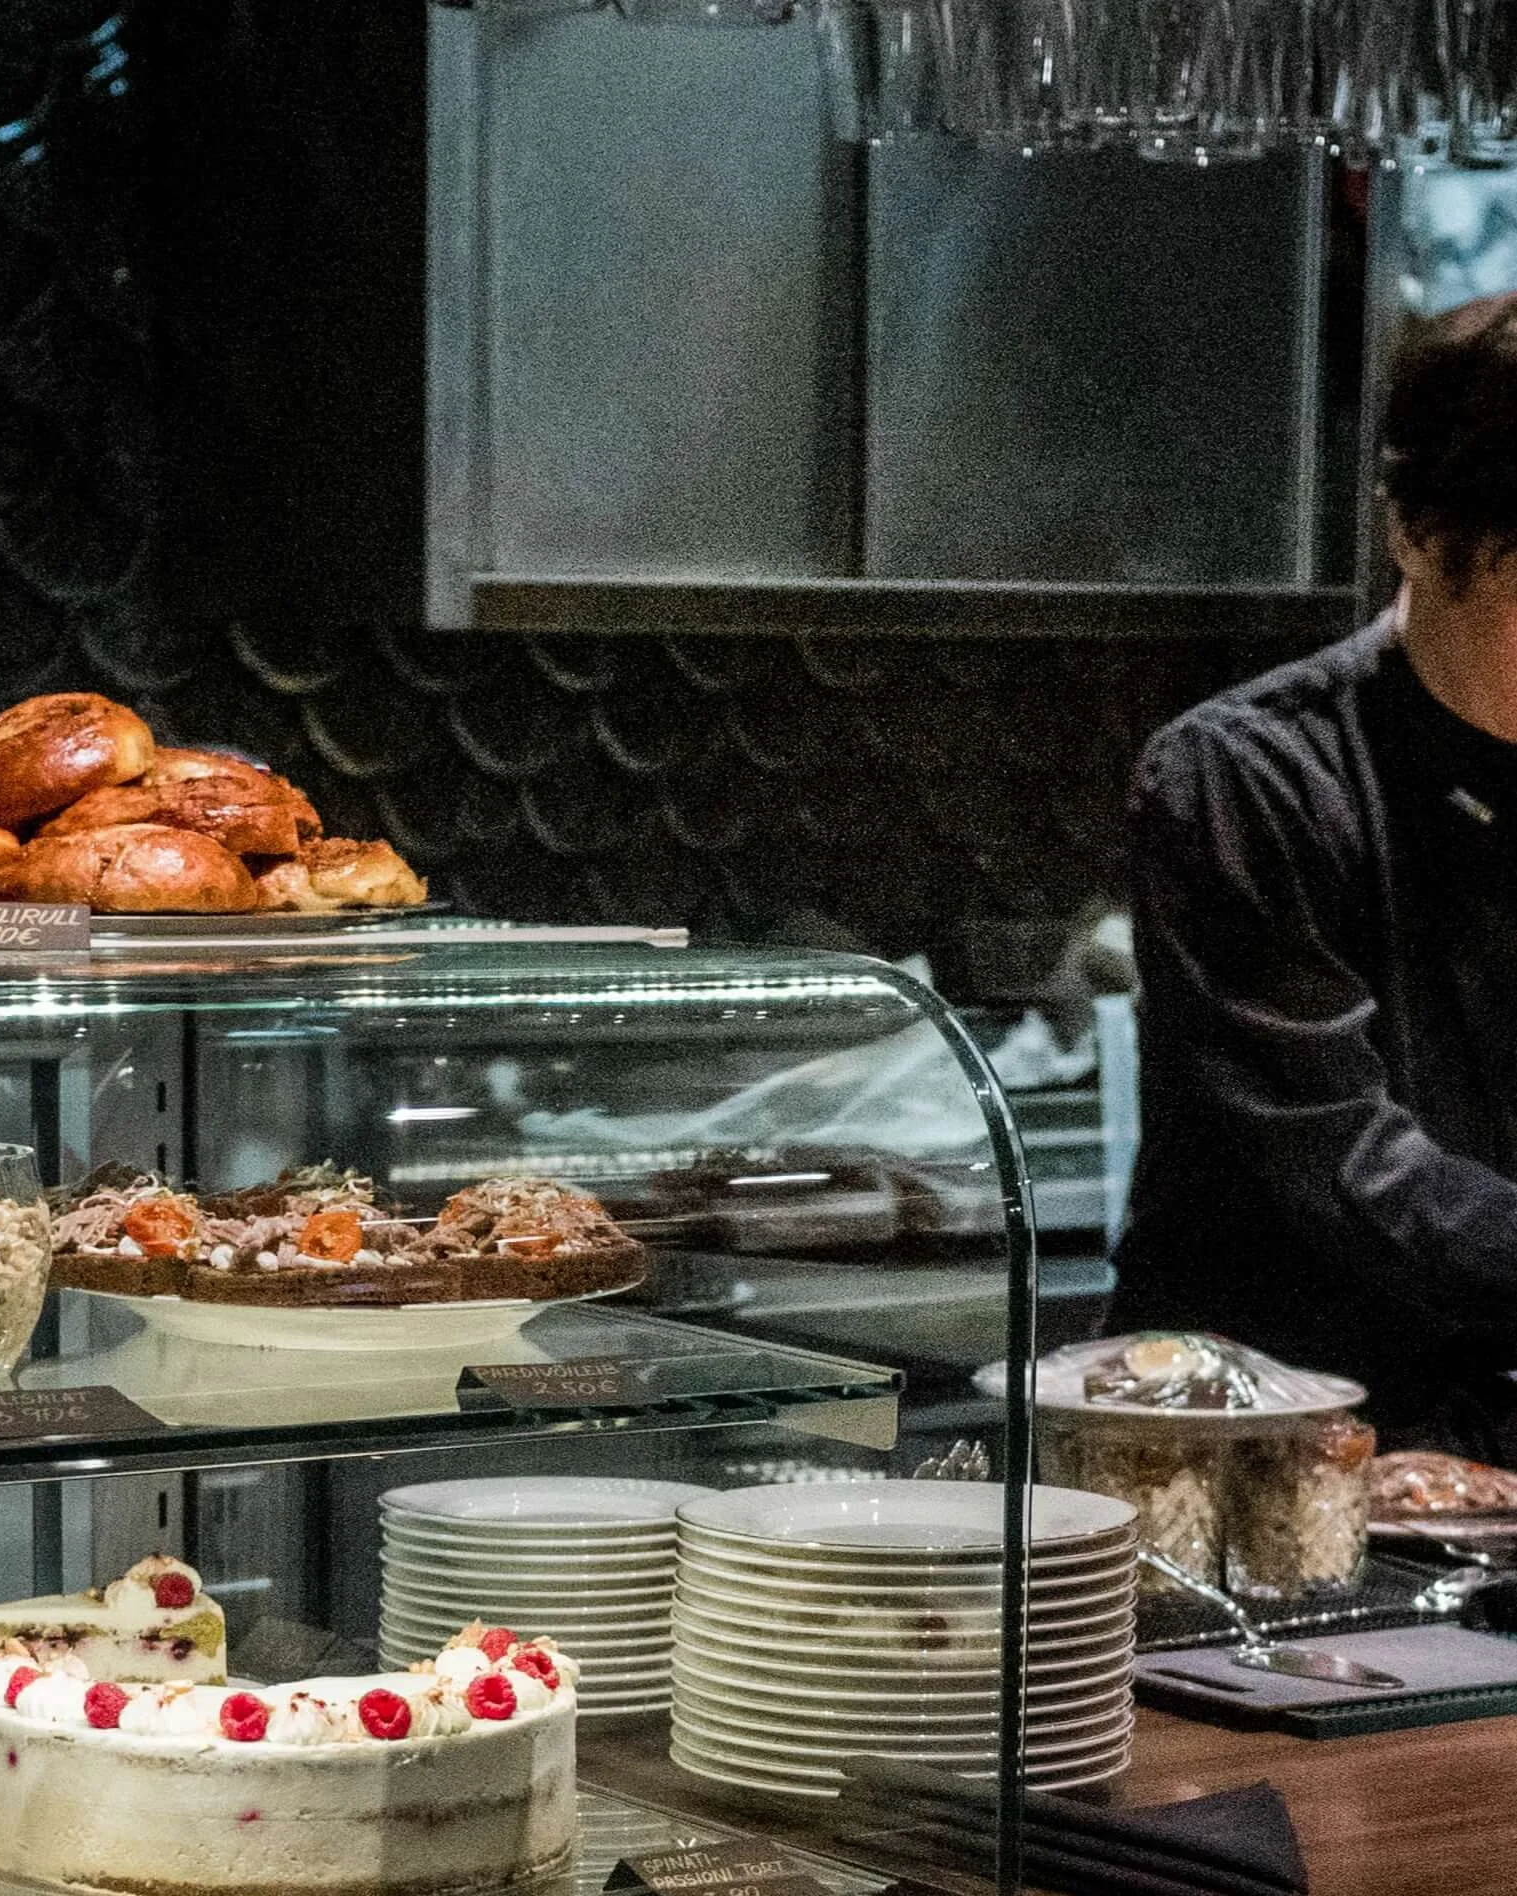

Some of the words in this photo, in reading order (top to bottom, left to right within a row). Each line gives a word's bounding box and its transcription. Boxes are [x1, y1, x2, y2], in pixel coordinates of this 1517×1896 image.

[641, 1851, 722, 1875] SPINATI-
[650, 1868, 734, 1891] PASSIONI
[742, 1860, 786, 1877] TORT
